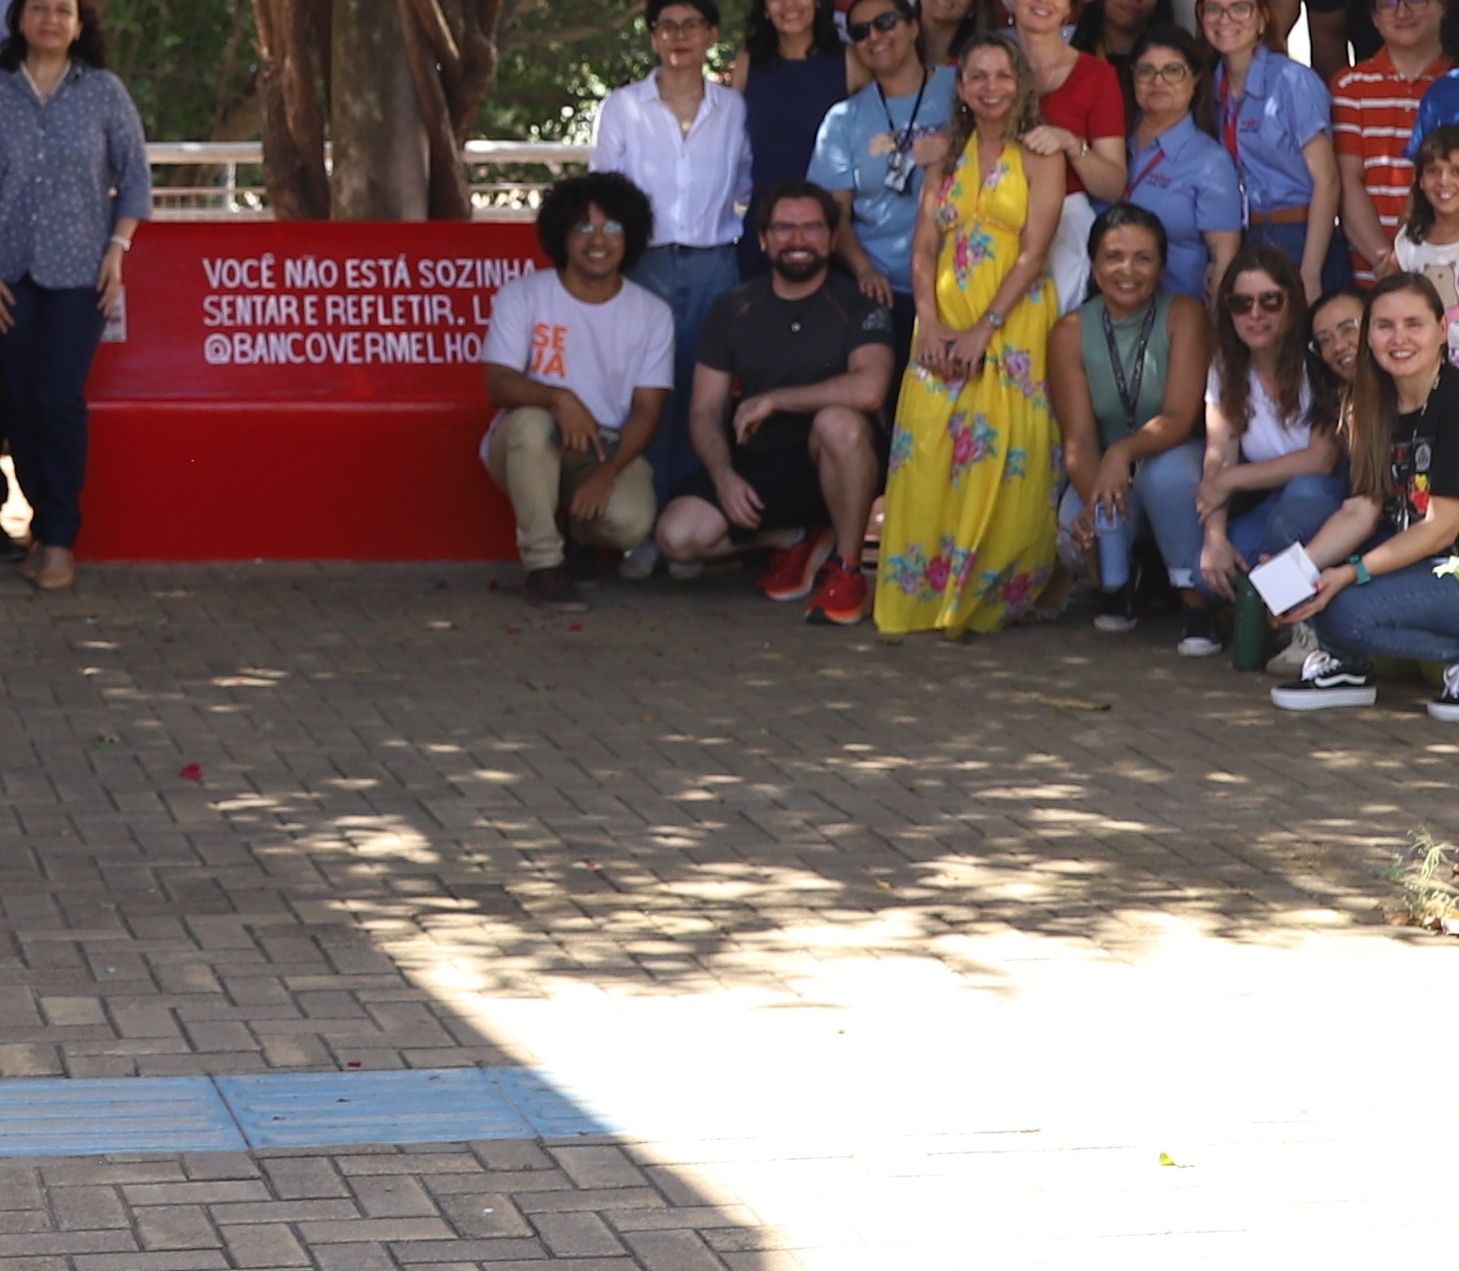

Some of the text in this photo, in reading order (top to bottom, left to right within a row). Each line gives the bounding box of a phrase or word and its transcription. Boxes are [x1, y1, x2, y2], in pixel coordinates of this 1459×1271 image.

[202, 252, 277, 289] VOCÊ
[284, 254, 339, 289] NÃO
[345, 253, 412, 289] ESTÁ
[202, 294, 300, 326] SENTAR
[304, 294, 319, 326] E
[325, 294, 466, 326] REFLETIR.
[204, 331, 482, 364] @BANCOVERMELHO
[532, 323, 567, 351] SE
